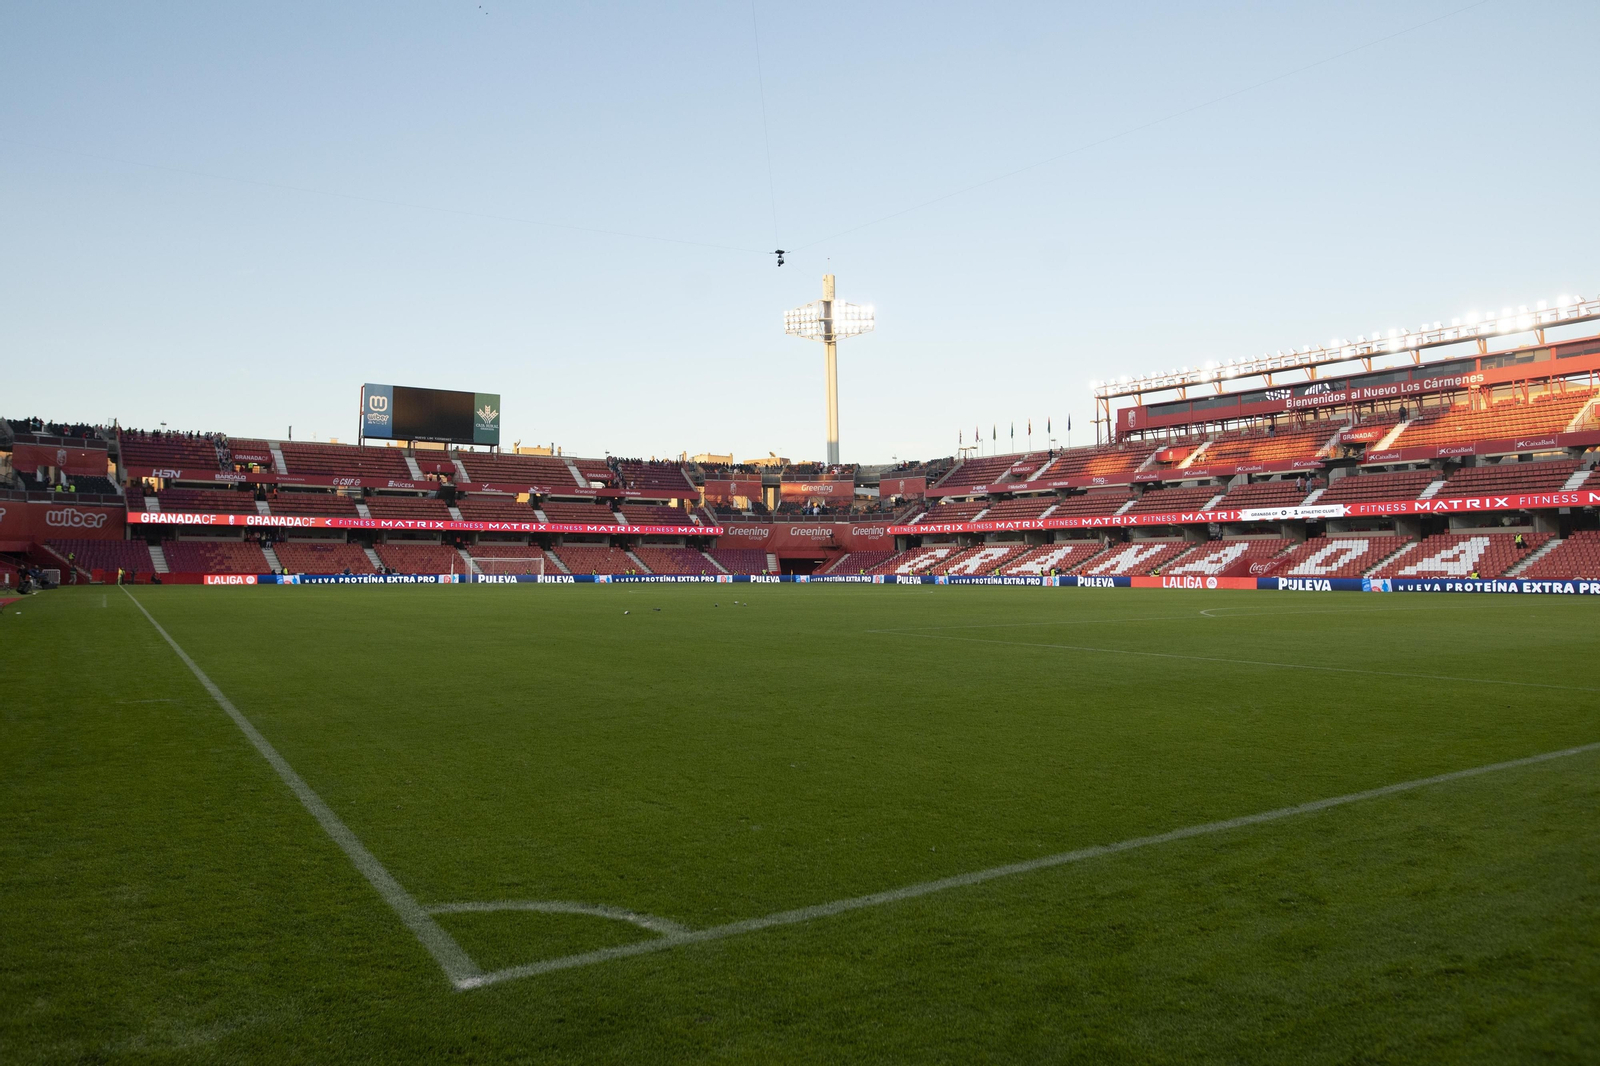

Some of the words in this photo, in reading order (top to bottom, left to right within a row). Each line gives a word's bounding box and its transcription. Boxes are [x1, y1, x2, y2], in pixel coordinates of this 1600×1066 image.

[1286, 393, 1346, 408] Bienvenidos
[1351, 390, 1360, 400] al
[1364, 386, 1397, 398] Nuevo
[1401, 382, 1420, 393] Los
[1424, 374, 1484, 389] Cármenes
[367, 412, 390, 422] wiber
[152, 469, 181, 478] HSN
[801, 484, 833, 492] Greening
[1360, 504, 1407, 513] FITNESS
[1415, 497, 1509, 511] MATRIX
[1520, 494, 1578, 505] FITNESS
[46, 508, 107, 528] wiber
[141, 513, 216, 524] GRANADACF
[246, 516, 315, 526] GRANADACF
[996, 521, 1044, 529] MATRIX
[1082, 516, 1138, 525] MATRIX
[728, 526, 769, 537] Greening
[790, 526, 832, 536] Greening
[852, 526, 884, 537] Greening
[208, 575, 243, 584] LALIGA
[339, 575, 386, 583] PROTEÍNA
[478, 574, 518, 583] PULEVA
[537, 574, 575, 583] PULEVA
[750, 575, 780, 583] PULEVA
[896, 575, 921, 584] PULEVA
[972, 576, 1002, 584] PROTEÍNA
[1078, 576, 1115, 587] PULEVA
[1163, 577, 1203, 588] LALIGA
[1278, 578, 1332, 591] PULEVA
[1399, 583, 1440, 592] NUEVA
[1446, 580, 1518, 592] PROTEÍNA
[1523, 582, 1575, 594] EXTRA
